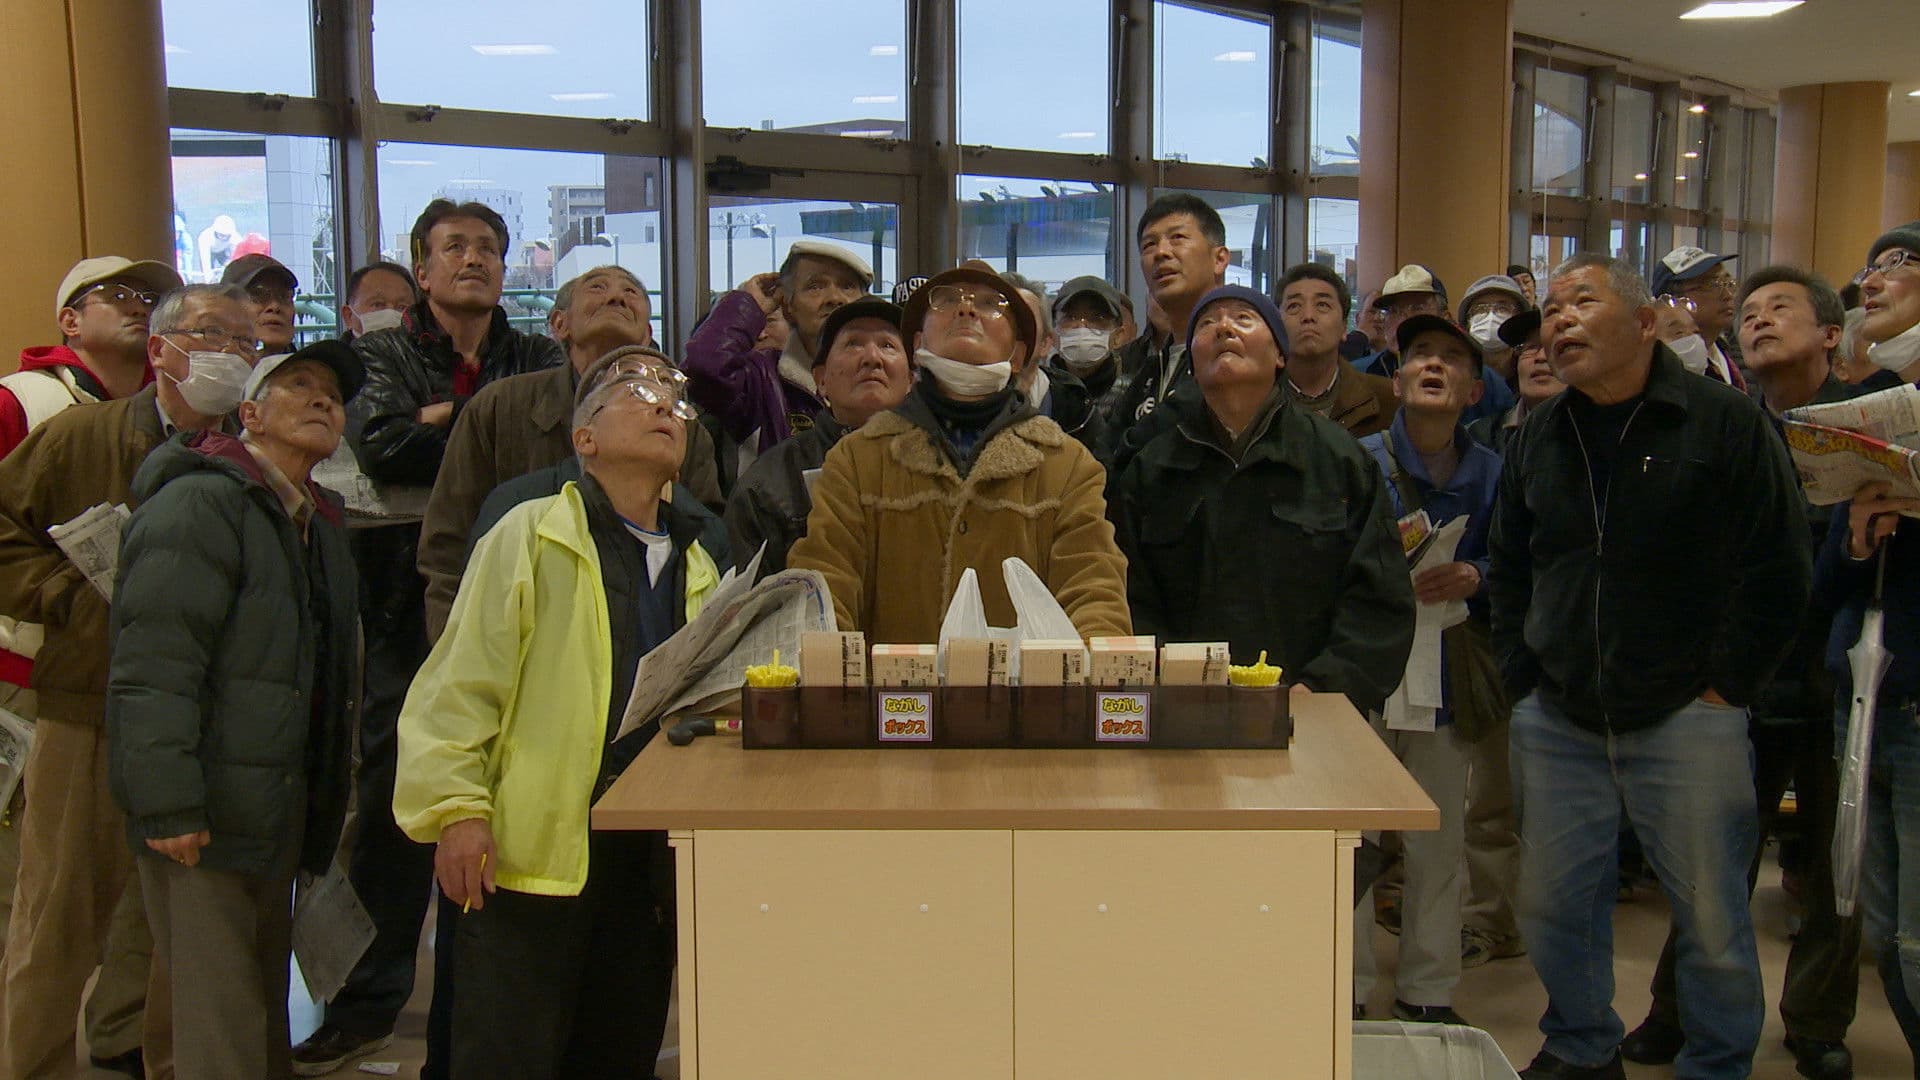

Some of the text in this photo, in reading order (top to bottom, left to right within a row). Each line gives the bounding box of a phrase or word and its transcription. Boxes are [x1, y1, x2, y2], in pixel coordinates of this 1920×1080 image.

[884, 697, 926, 713] ながし
[1102, 697, 1144, 713] ながし
[884, 718, 927, 735] ボックス
[1101, 718, 1144, 735] ボックス
